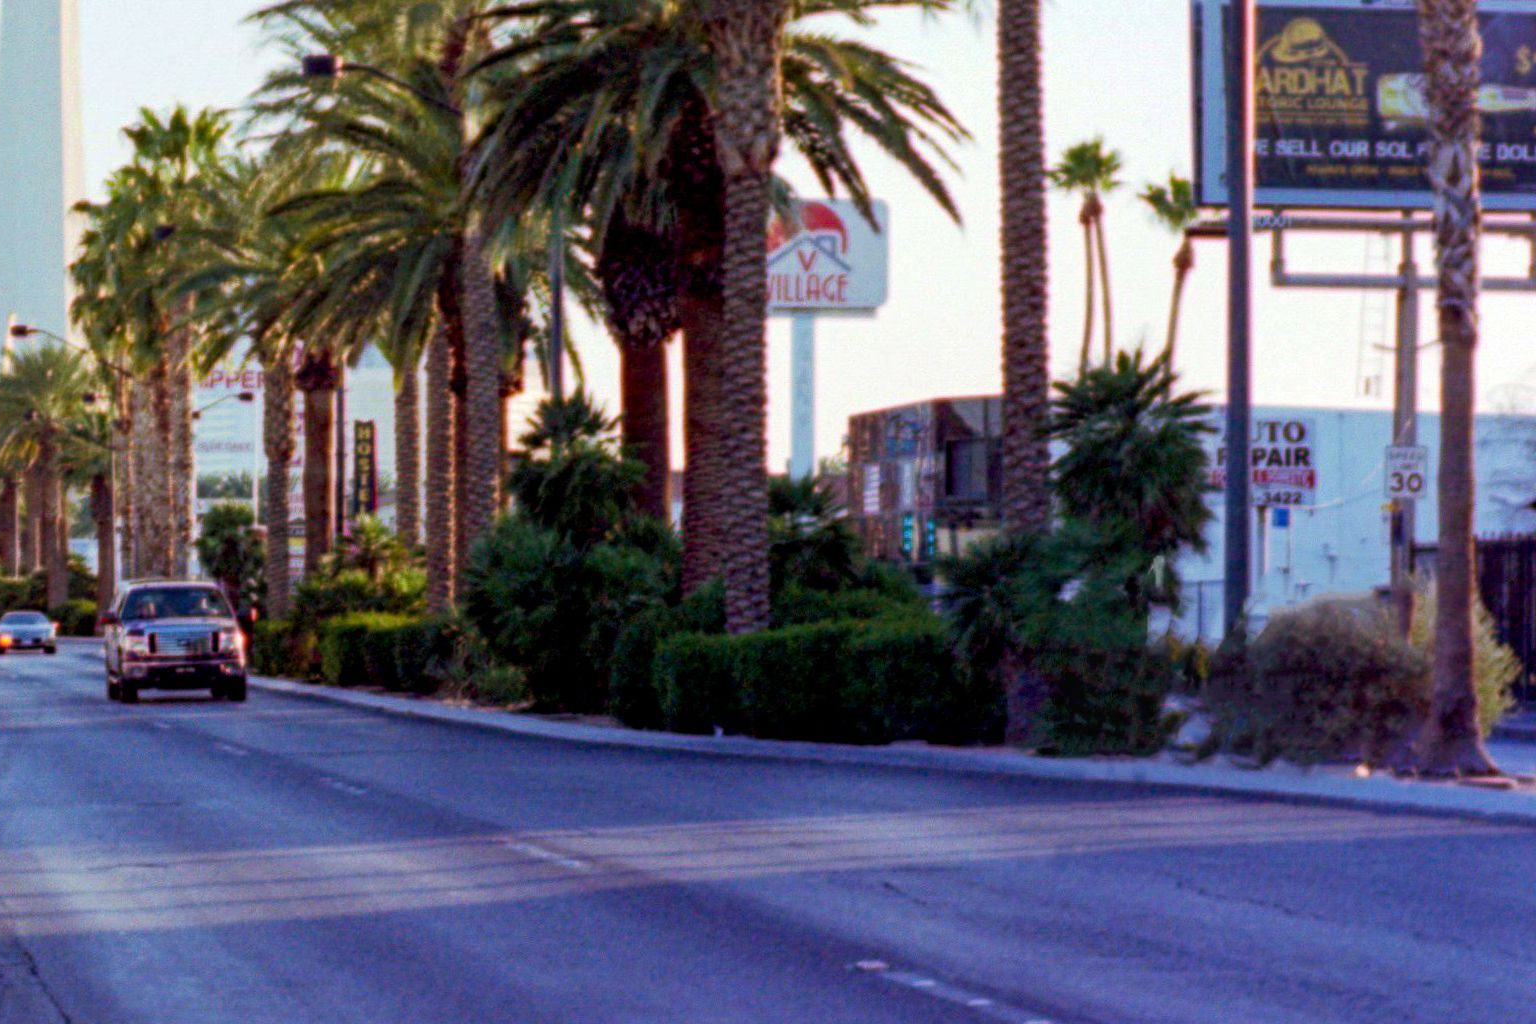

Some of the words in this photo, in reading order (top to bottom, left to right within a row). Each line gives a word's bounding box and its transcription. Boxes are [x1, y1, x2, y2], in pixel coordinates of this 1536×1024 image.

[1256, 65, 1369, 95] ARDHAT
[1276, 139, 1322, 157] SELL
[1330, 140, 1369, 157] OUR
[1391, 472, 1423, 493] 30
